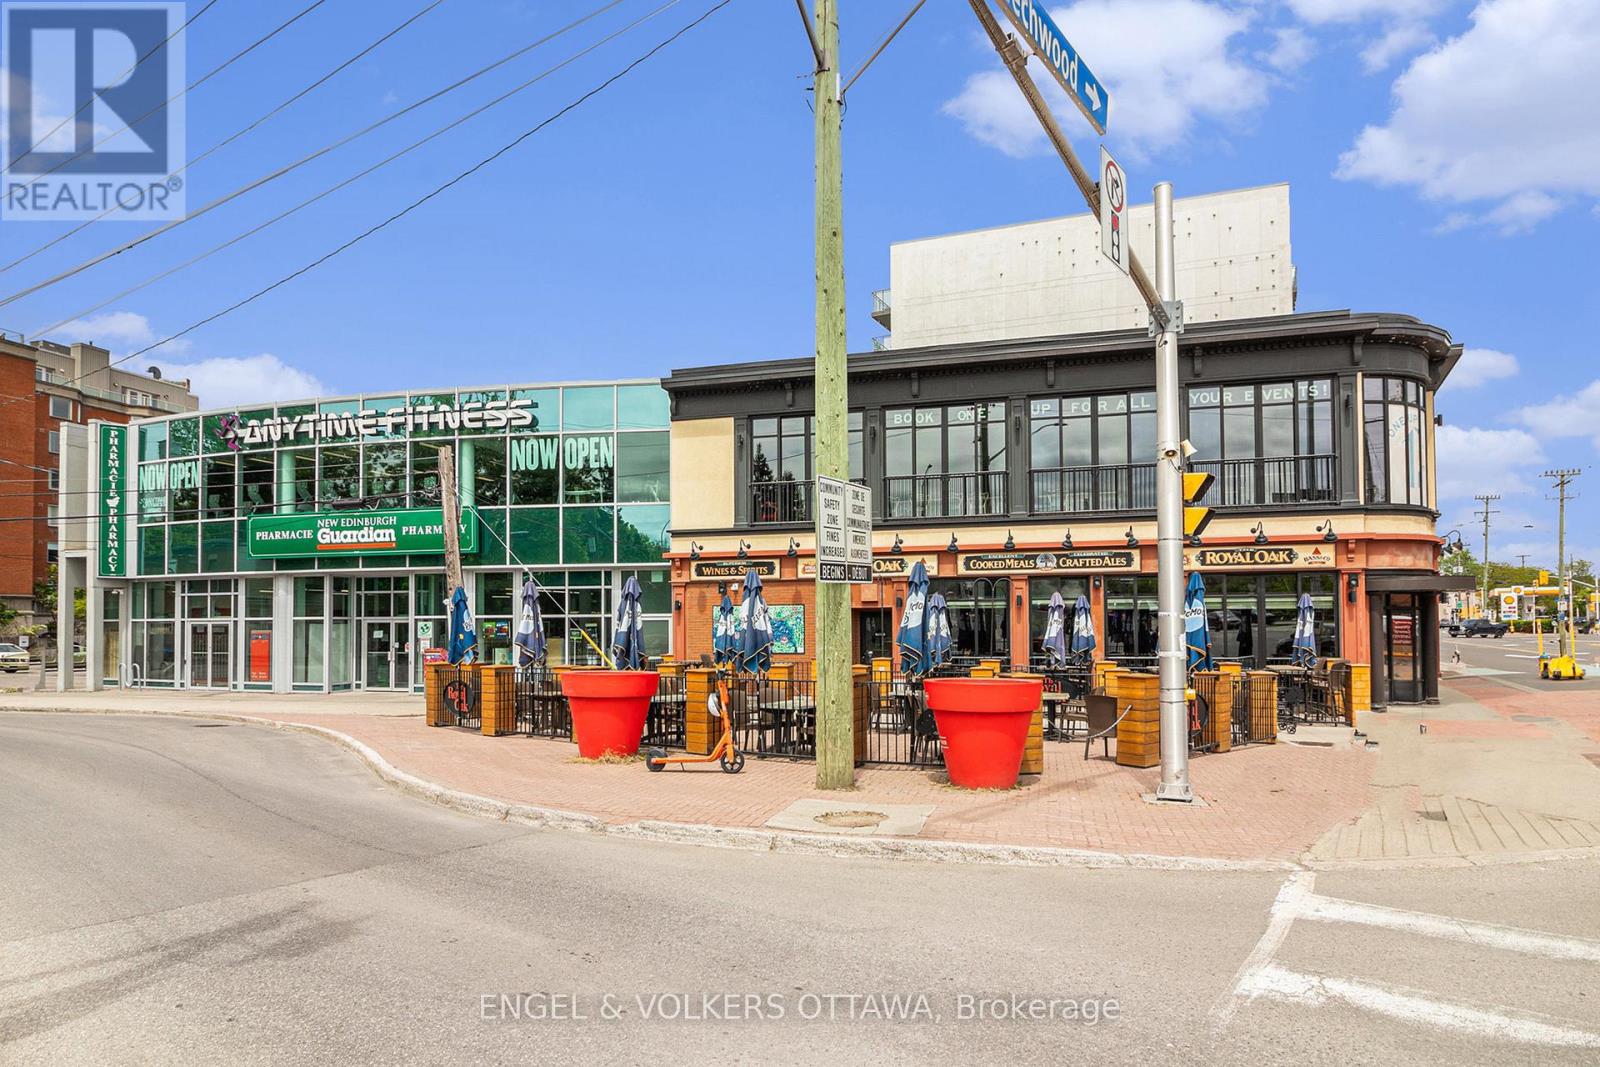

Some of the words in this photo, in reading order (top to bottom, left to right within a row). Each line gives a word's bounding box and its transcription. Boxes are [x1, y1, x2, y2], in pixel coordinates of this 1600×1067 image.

[894, 413, 934, 424] BOOK
[956, 408, 987, 422] ONE
[1031, 403, 1051, 415] UP
[1071, 401, 1108, 413] FOR
[1116, 397, 1151, 410] ALL
[1190, 392, 1232, 405] YOUR
[243, 409, 378, 443] ANYTIME
[386, 399, 536, 433] FITNESS
[512, 438, 559, 471] NOW
[564, 436, 614, 469] OPEN
[108, 430, 120, 497] PHARMACIE
[139, 463, 166, 493] NOW
[170, 461, 200, 490] OPEN
[820, 482, 843, 496] COMMUNITY
[823, 498, 840, 511] SAFETY
[317, 518, 338, 528] NEW
[340, 516, 397, 527] EDINBURGH
[827, 513, 838, 525] ZONE
[255, 529, 313, 541] PHARMACIE
[317, 527, 396, 544] Guardian
[402, 524, 467, 536] PHARMY
[107, 508, 119, 572] PHARMACY
[826, 531, 839, 543] FINES
[820, 546, 845, 558] INCREASED
[1205, 551, 1254, 564] ROYAL
[1256, 550, 1291, 564] OAK
[873, 559, 902, 572] OAK
[970, 559, 1006, 569] COOKED
[1005, 558, 1035, 568] MEALS
[1059, 557, 1102, 567] CRAFTED
[1103, 556, 1127, 566] ALES
[702, 566, 729, 576] WINES
[730, 566, 737, 575] &
[822, 565, 845, 580] BEGINS
